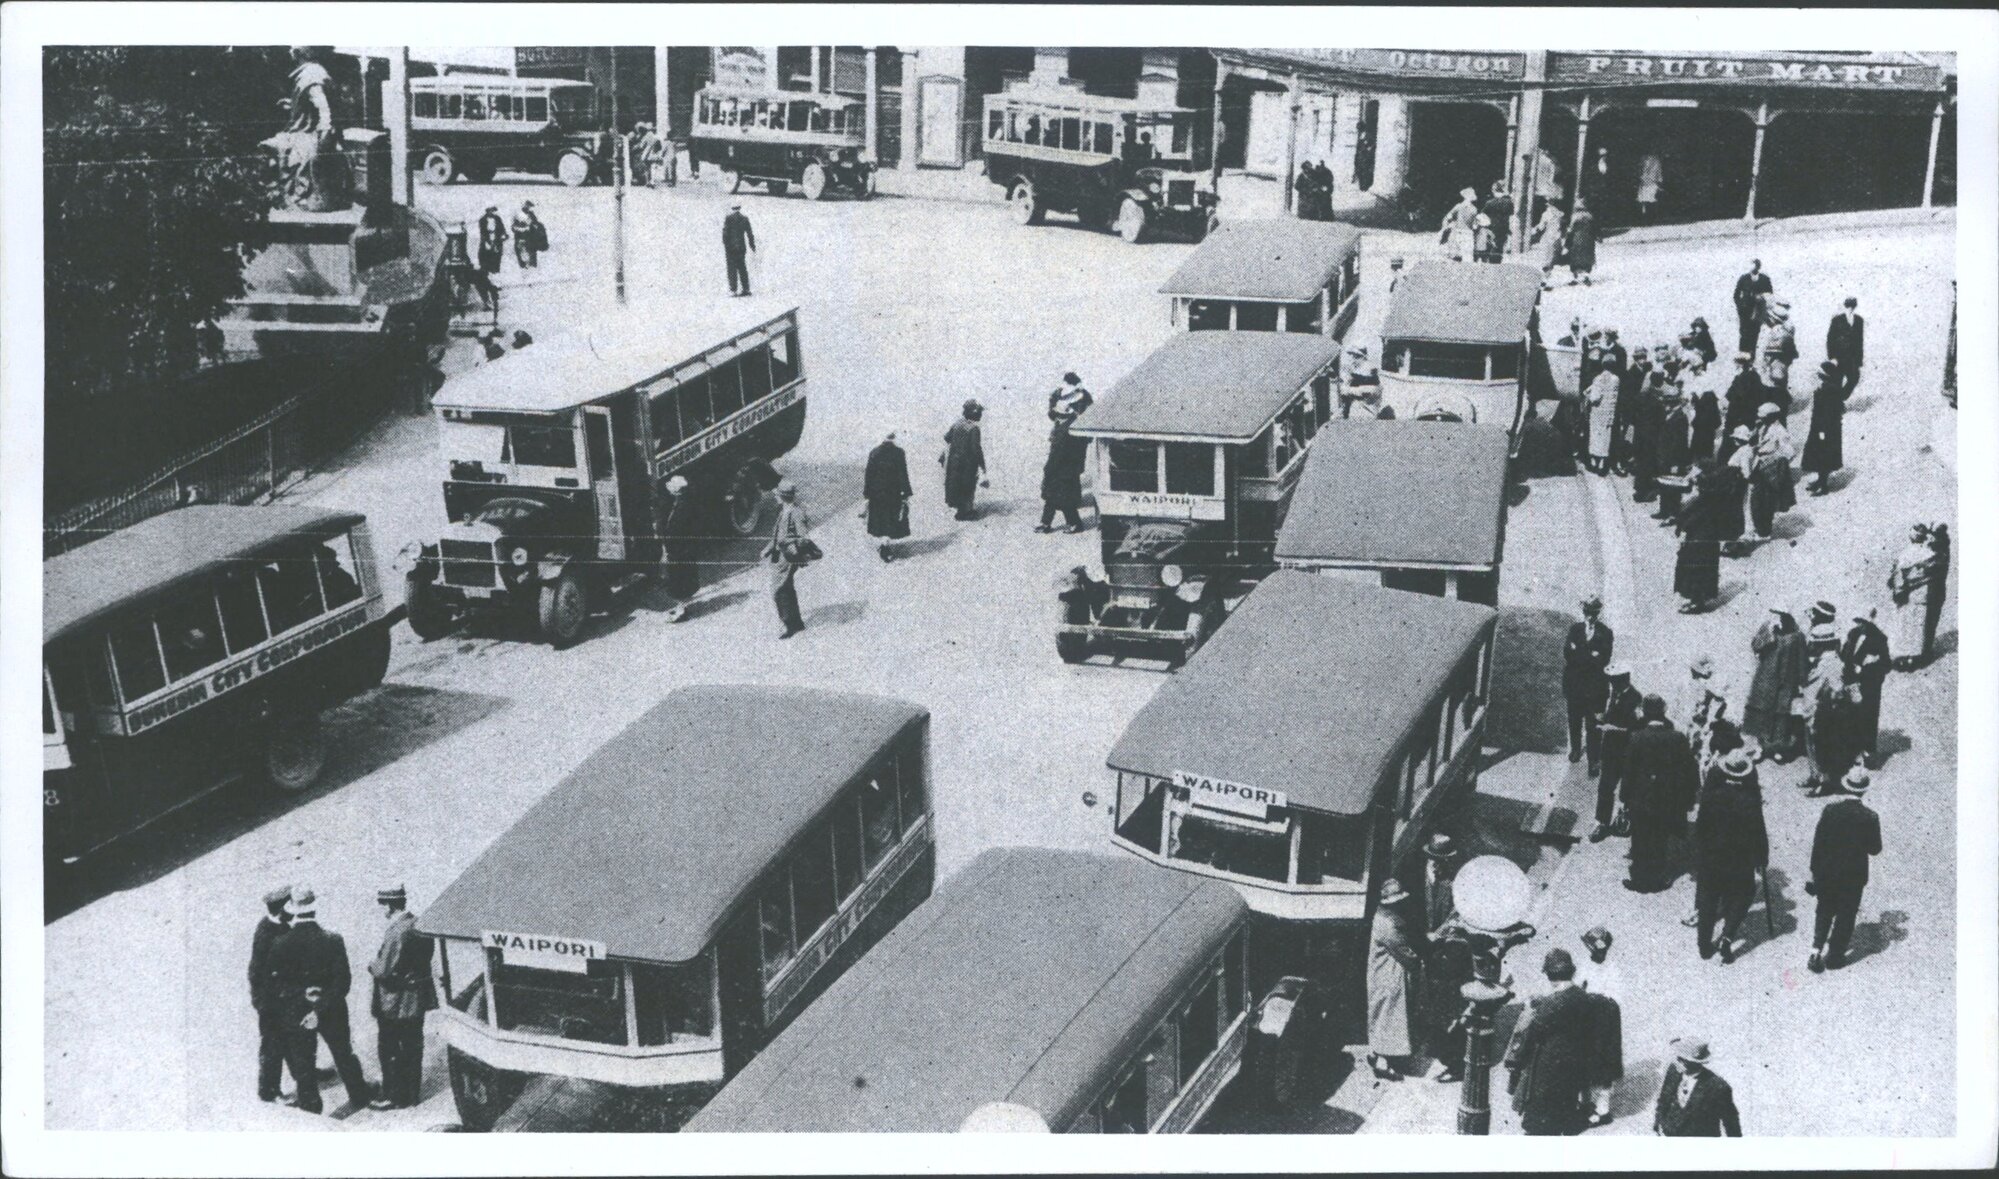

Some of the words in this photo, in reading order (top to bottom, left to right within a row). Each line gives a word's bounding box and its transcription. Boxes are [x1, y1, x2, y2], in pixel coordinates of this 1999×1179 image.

[1389, 50, 1510, 73] Octagon
[1768, 62, 1902, 82] MART
[705, 425, 728, 450] CITY
[1130, 495, 1196, 505] WAIPORI
[211, 661, 254, 694] CITY
[1182, 774, 1276, 804] WAIPORI
[491, 933, 595, 958] WAIPORI
